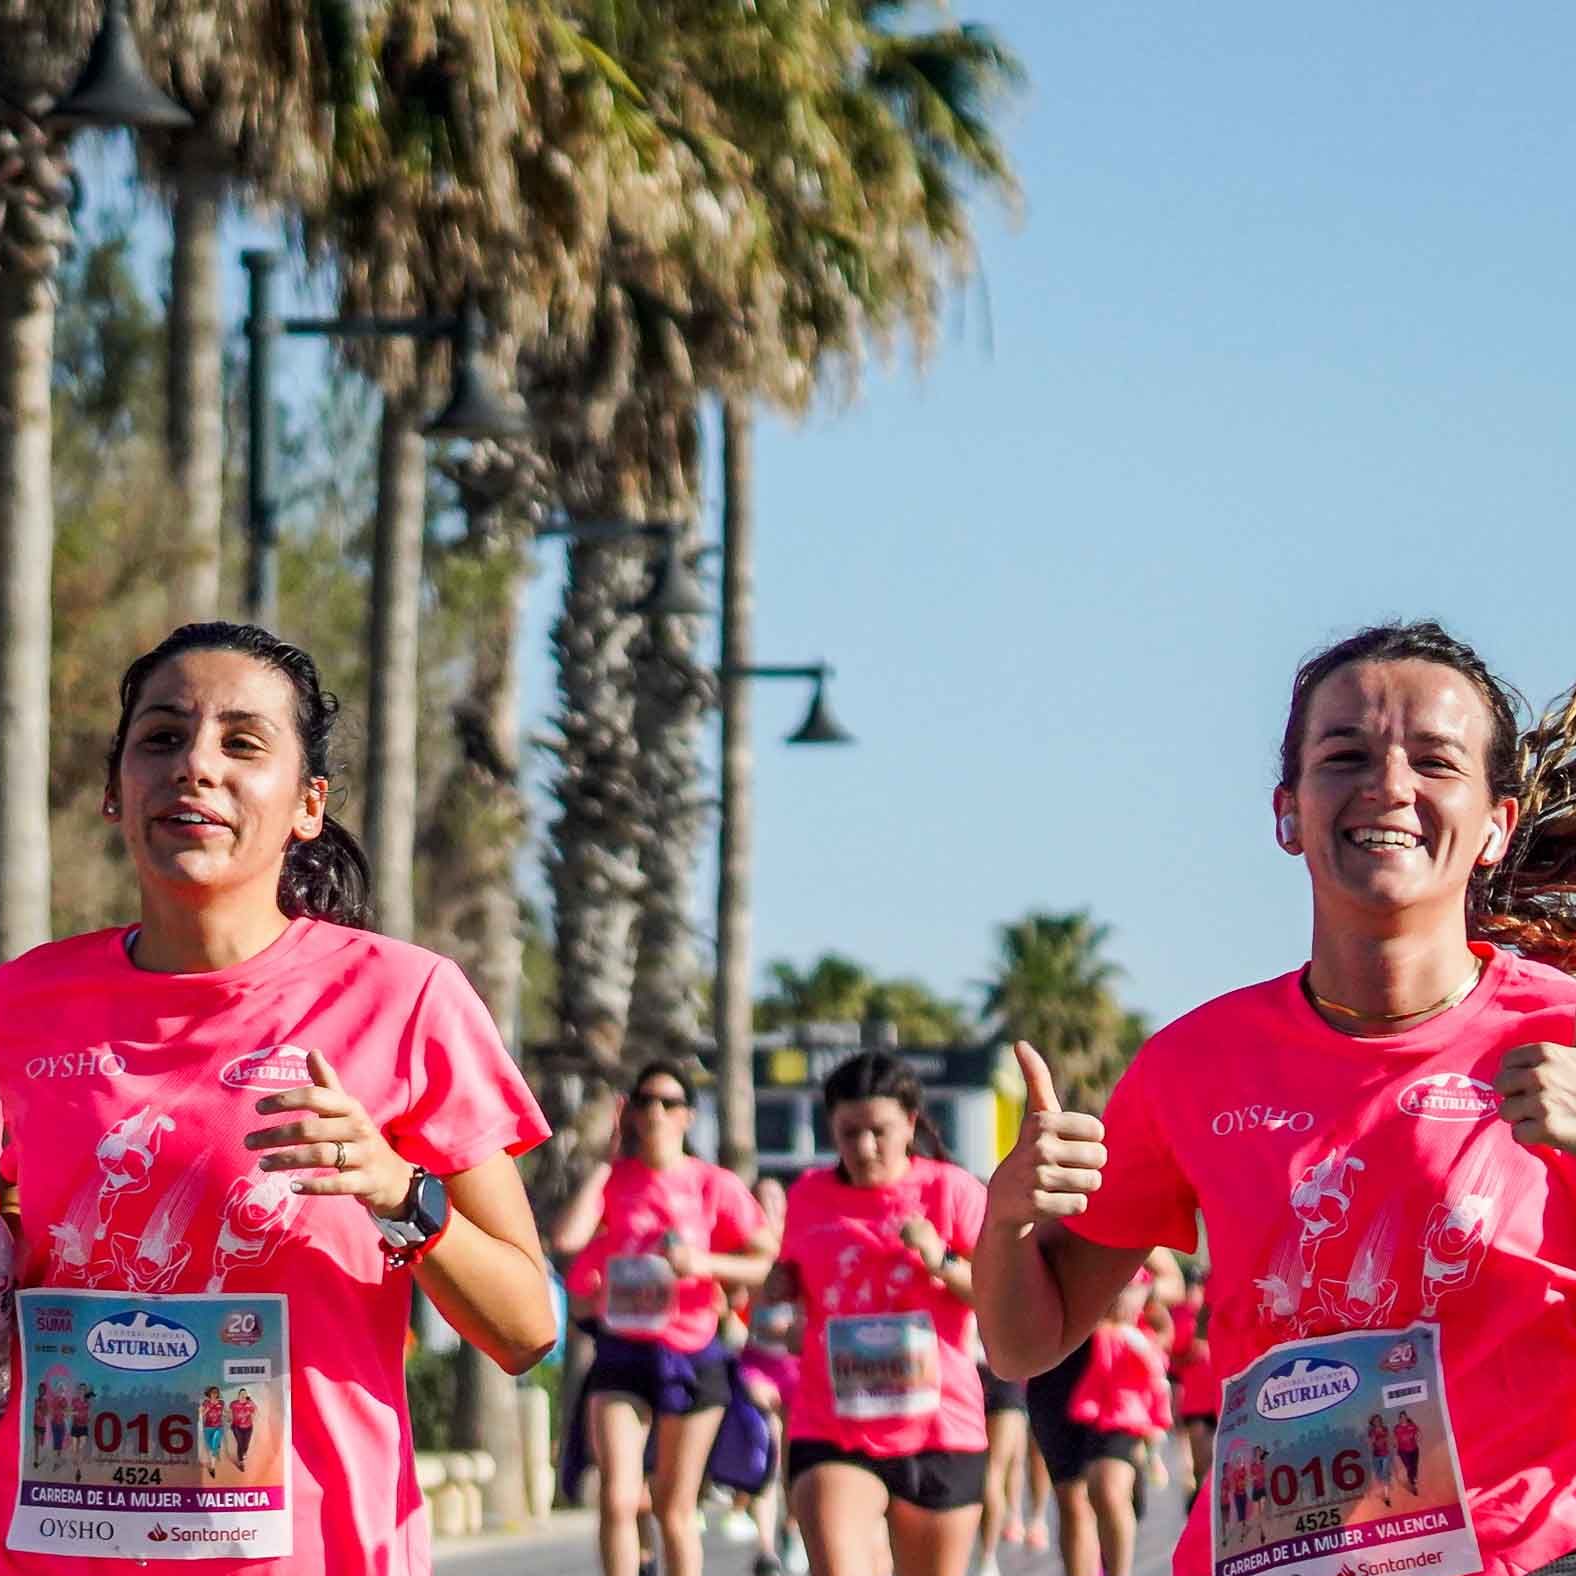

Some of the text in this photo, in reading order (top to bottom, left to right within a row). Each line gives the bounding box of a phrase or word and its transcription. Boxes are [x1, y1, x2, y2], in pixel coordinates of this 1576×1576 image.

[25, 1053, 127, 1079] OYSHO
[231, 1063, 311, 1080] ASTURIAN
[1212, 1104, 1314, 1135] OYSHO
[228, 1313, 256, 1333] 20
[93, 1330, 190, 1357] ASTURIANA
[1262, 1377, 1352, 1413] ASTURIANA
[94, 1411, 194, 1455] 016
[113, 1466, 162, 1486] 4524
[1270, 1450, 1365, 1506] 016
[31, 1487, 270, 1508] CARRERA DE LA MUJER VALENCIA
[40, 1517, 114, 1541] OYSHO
[1295, 1508, 1342, 1533] 4525
[172, 1527, 257, 1542] Santander
[1274, 1546, 1290, 1562] DE
[1293, 1543, 1311, 1558] LA
[1314, 1529, 1364, 1552] MUJER
[1375, 1512, 1449, 1539] VALENCIA
